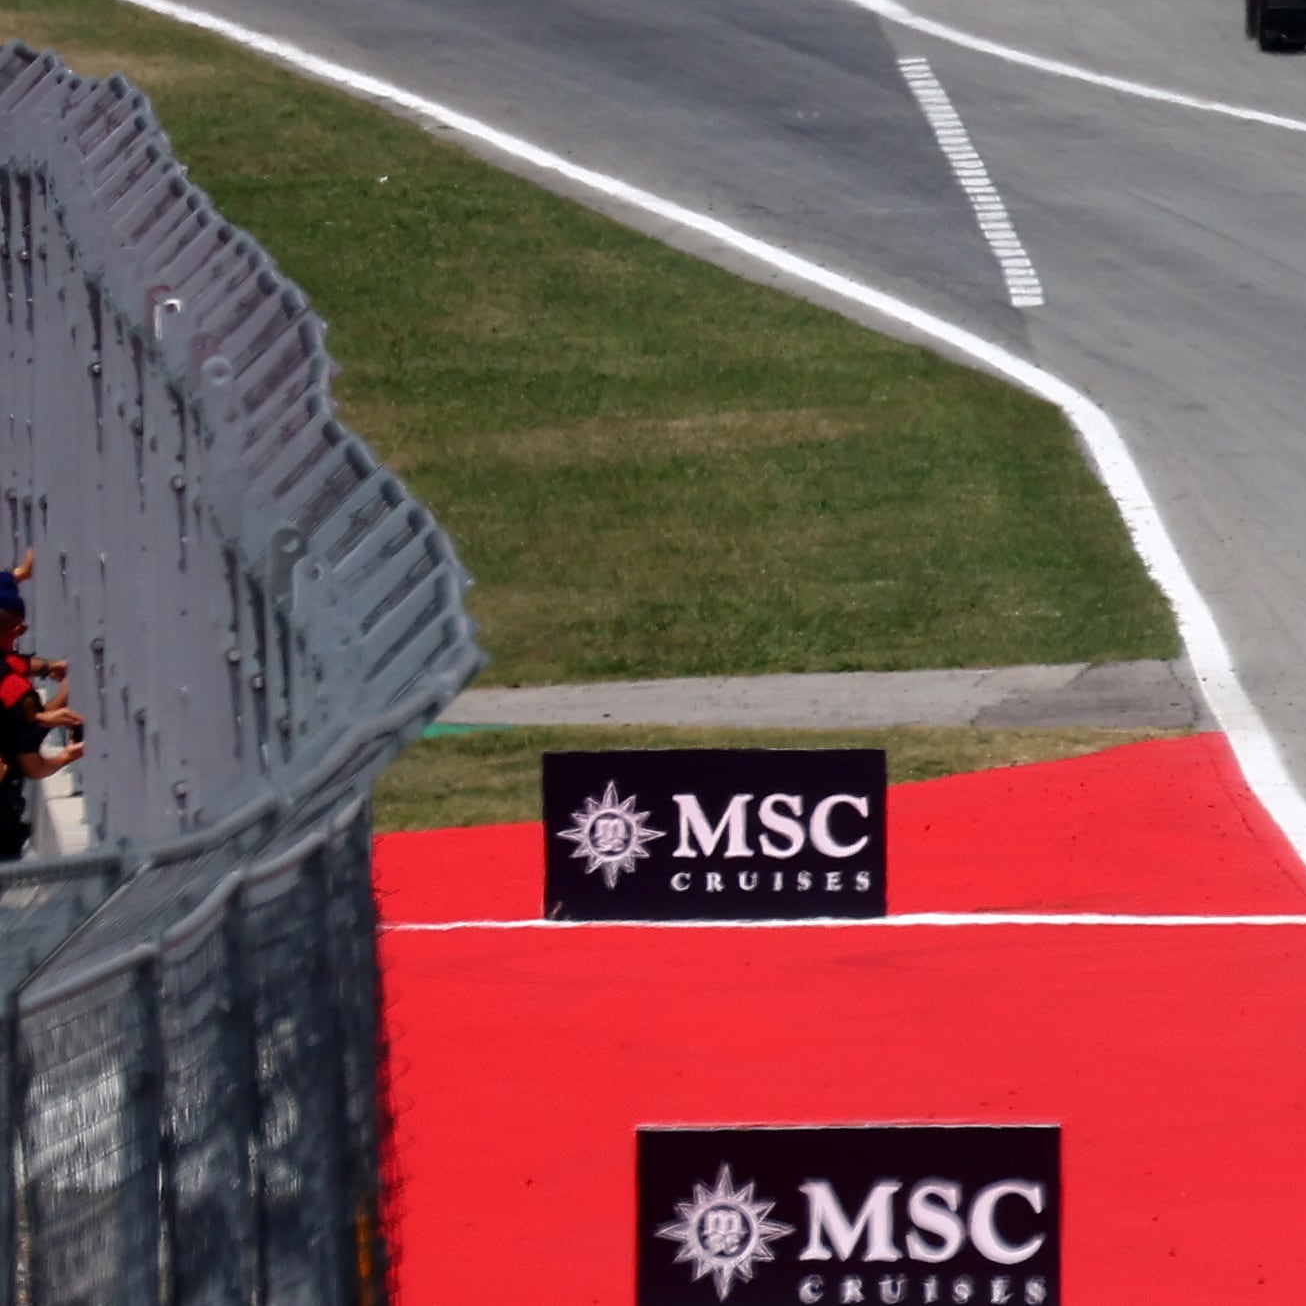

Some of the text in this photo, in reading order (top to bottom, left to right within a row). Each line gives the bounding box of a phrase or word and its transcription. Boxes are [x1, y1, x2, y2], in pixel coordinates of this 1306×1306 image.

[672, 793, 870, 859] MSC
[671, 870, 872, 892] CRUISES
[799, 1179, 1044, 1265] MSC
[798, 1274, 1046, 1305] CRUISES
